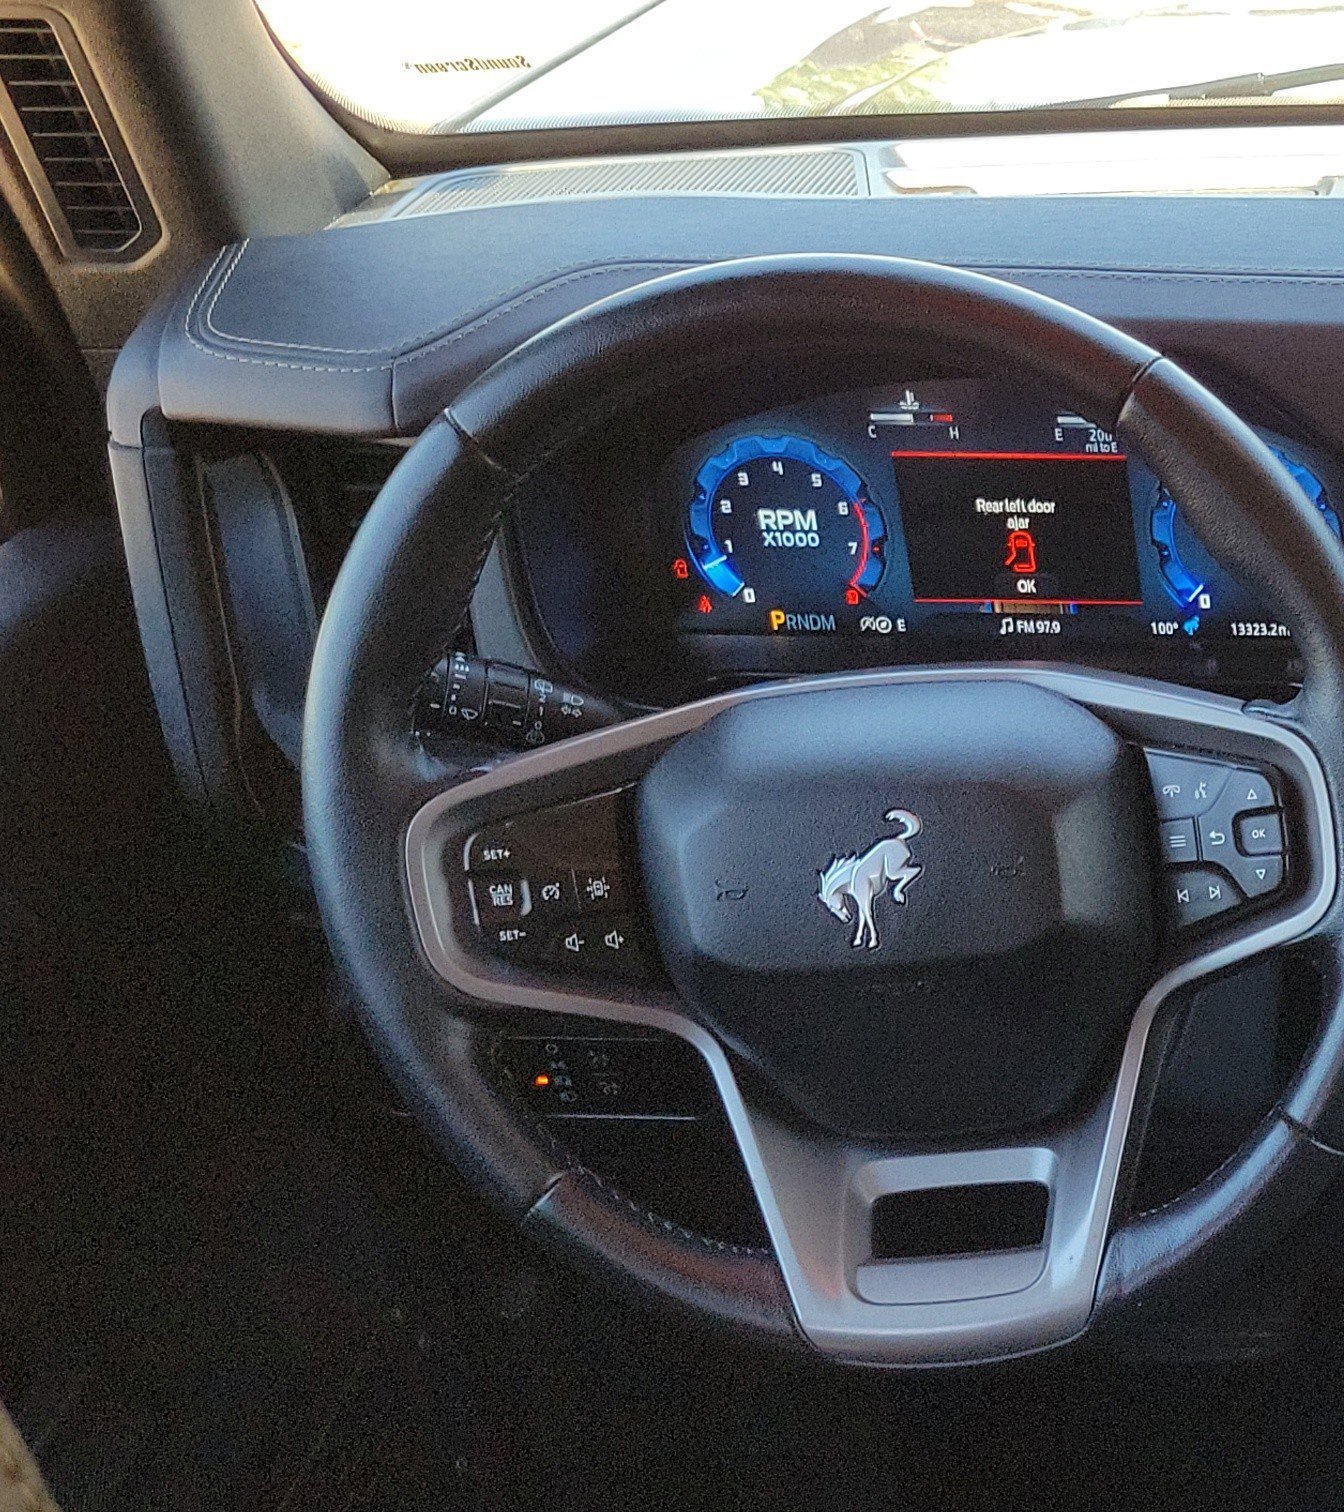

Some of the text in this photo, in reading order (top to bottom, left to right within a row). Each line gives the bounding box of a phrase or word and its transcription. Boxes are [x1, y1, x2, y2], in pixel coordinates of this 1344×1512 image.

[867, 425, 877, 438] C
[950, 427, 960, 439] H
[1055, 428, 1064, 442] E
[772, 461, 784, 475] 4
[737, 472, 749, 486] 3
[811, 473, 823, 487] 5
[720, 500, 732, 514] 2
[837, 501, 849, 516] 6
[976, 498, 1003, 513] Rear
[1027, 498, 1056, 514] door
[757, 509, 818, 531] RPM
[725, 540, 733, 553] 1
[848, 541, 858, 555] 7
[1017, 579, 1037, 593] OK
[1017, 620, 1061, 634] FM 97.9
[1251, 829, 1267, 839] OK
